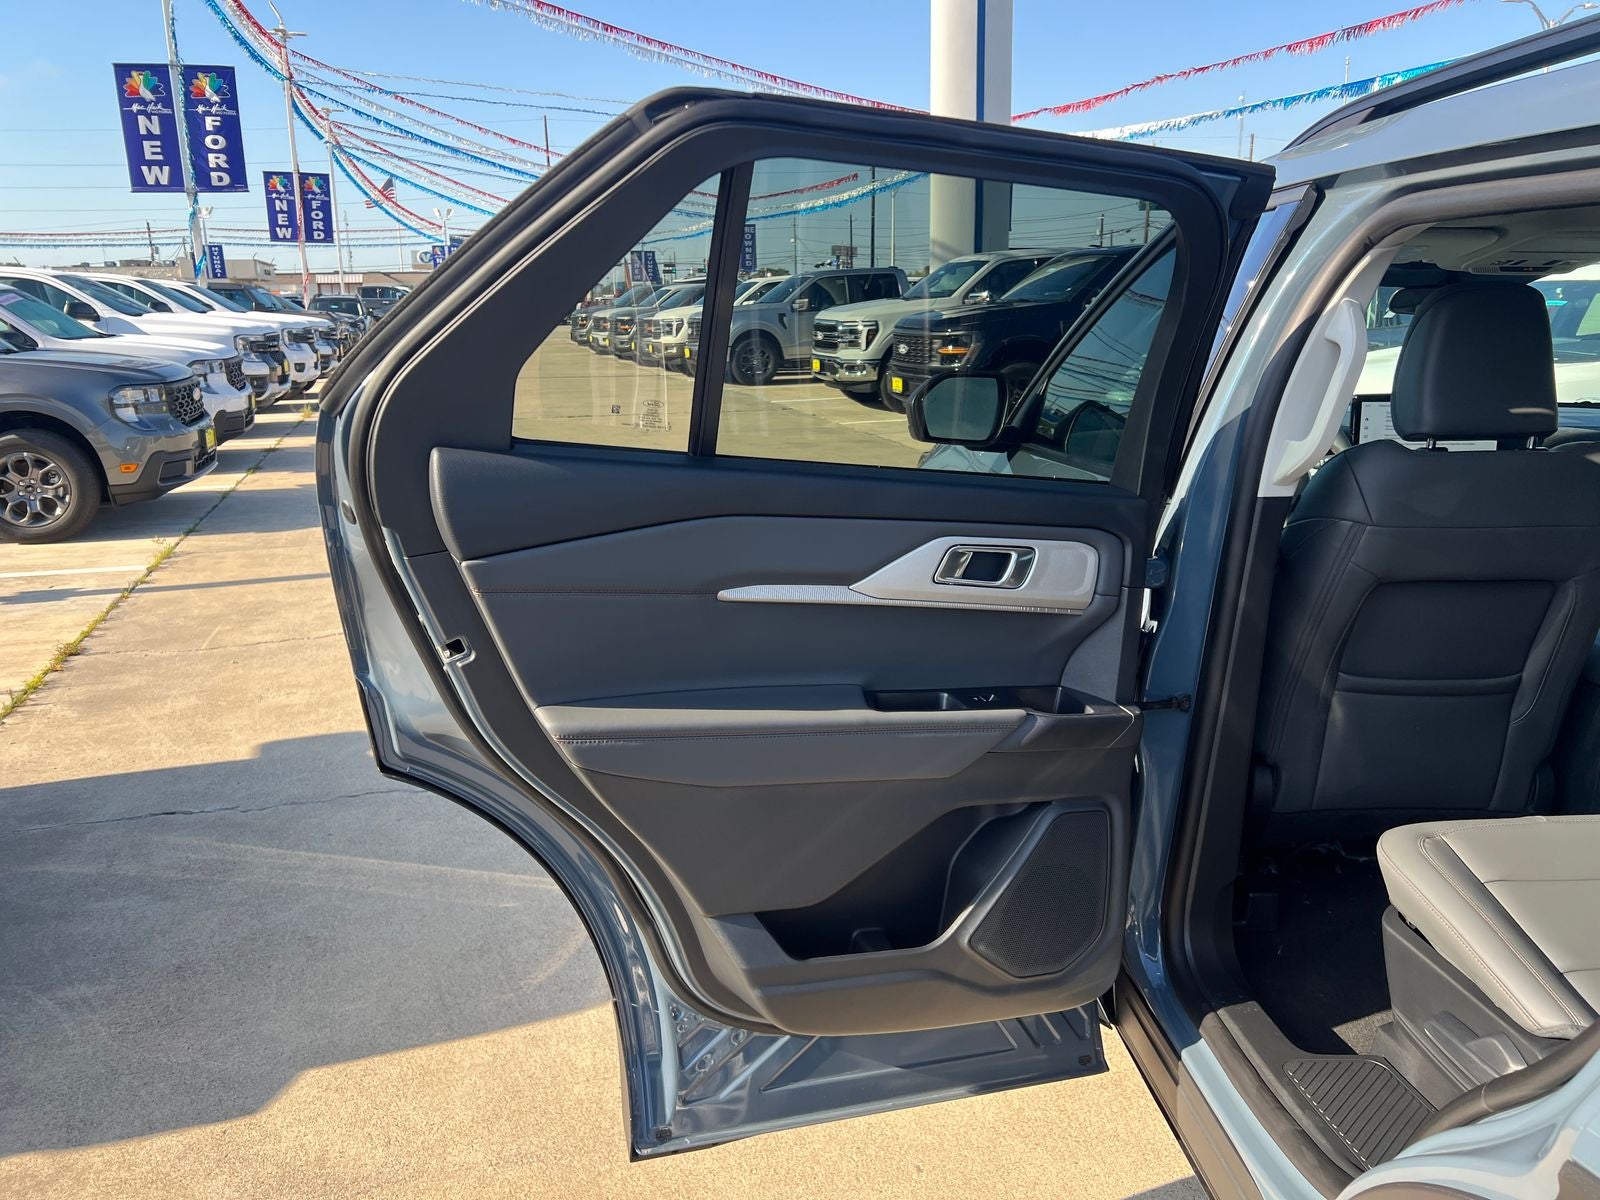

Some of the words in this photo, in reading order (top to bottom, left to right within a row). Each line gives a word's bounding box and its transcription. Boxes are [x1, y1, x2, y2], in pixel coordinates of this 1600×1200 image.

[137, 115, 170, 185] NEW
[204, 116, 231, 187] FORD
[275, 199, 293, 239] NEW
[310, 200, 325, 240] FORD
[211, 246, 222, 278] HYUNDAI
[744, 233, 753, 267] OWNED
